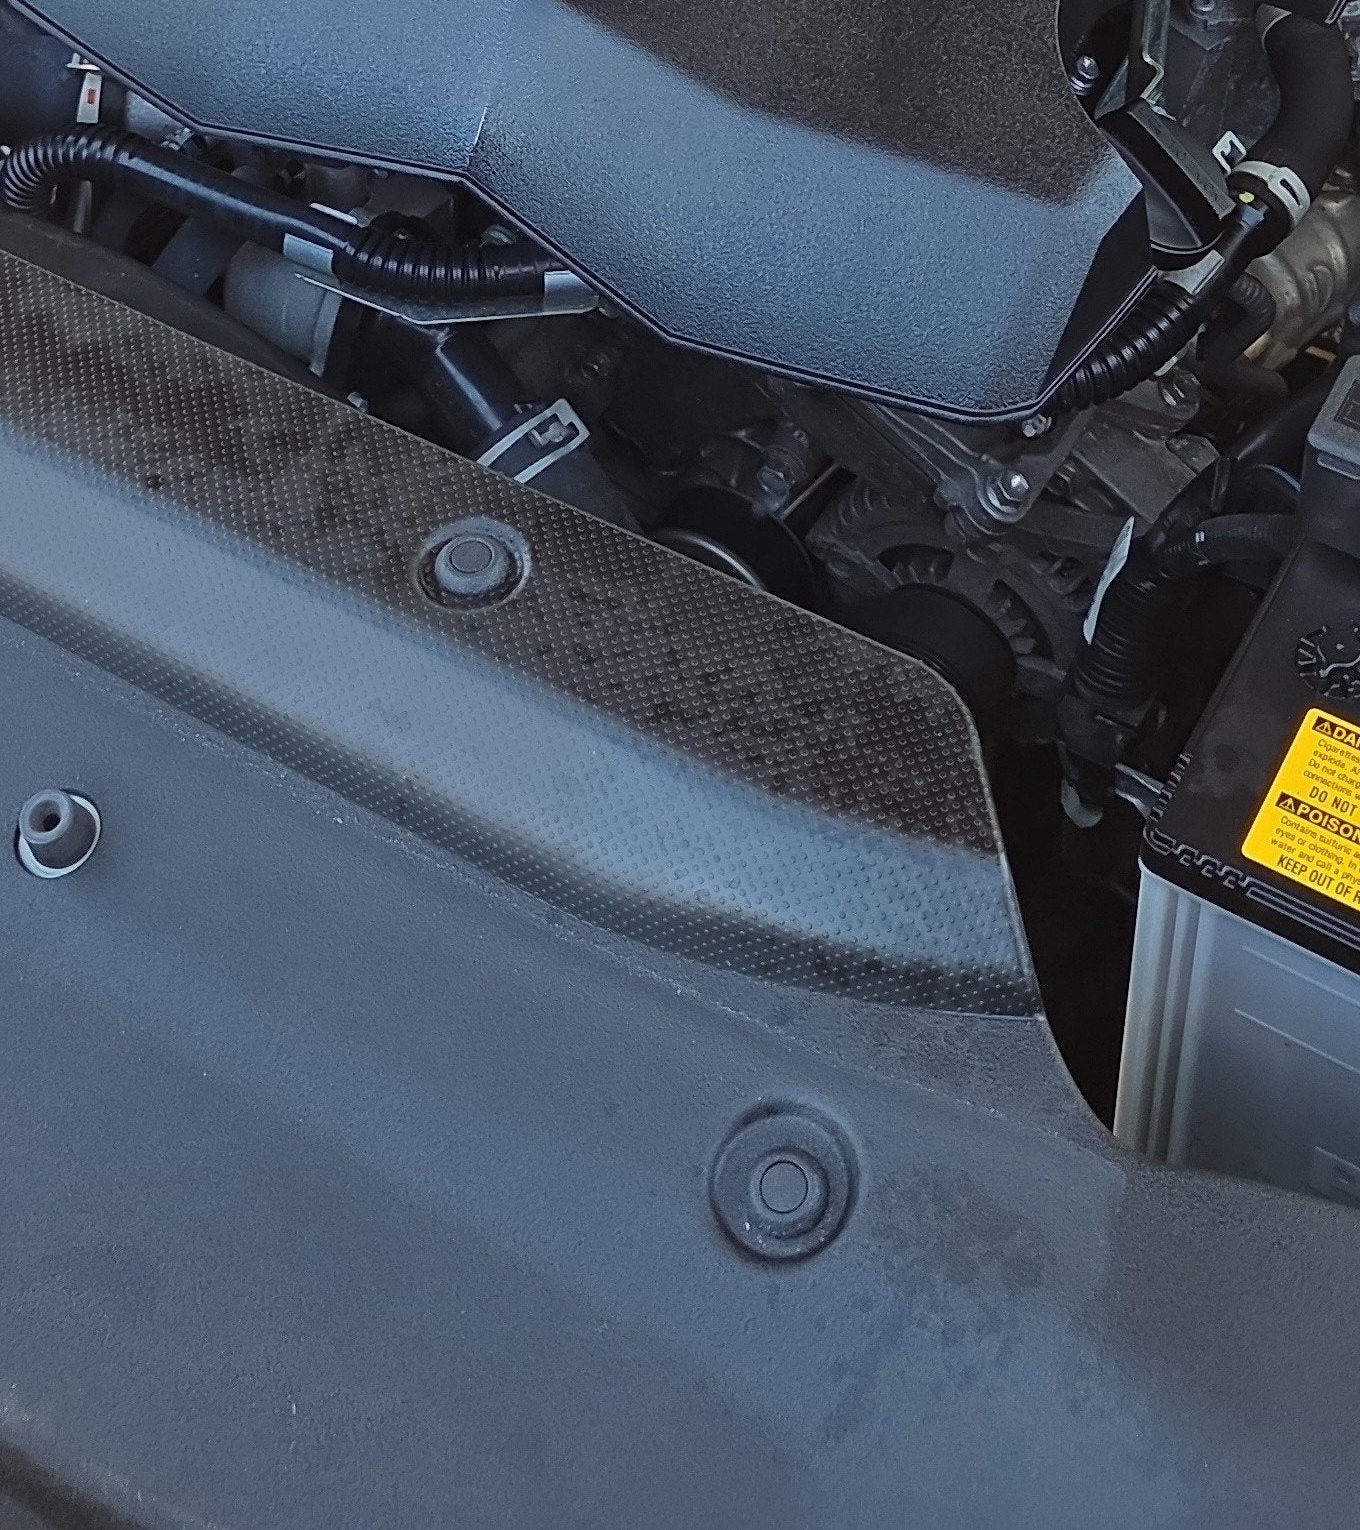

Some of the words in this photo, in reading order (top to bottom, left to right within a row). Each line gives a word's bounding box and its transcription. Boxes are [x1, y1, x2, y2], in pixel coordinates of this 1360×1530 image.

[1303, 770, 1353, 796] connections
[1308, 758, 1320, 769] Do
[1321, 765, 1337, 777] not
[1309, 786, 1328, 803] DO
[1331, 796, 1358, 816] NOT
[1275, 828, 1296, 841] eyes
[1297, 838, 1307, 846] or
[1348, 860, 1357, 870] In
[1281, 816, 1317, 839] Contains
[1319, 835, 1352, 855] sulfuric
[1271, 838, 1296, 854] water
[1298, 851, 1315, 863] and
[1315, 859, 1333, 871] call
[1277, 854, 1308, 876] KEEP
[1309, 869, 1335, 890] OUT
[1335, 882, 1353, 897] OF
